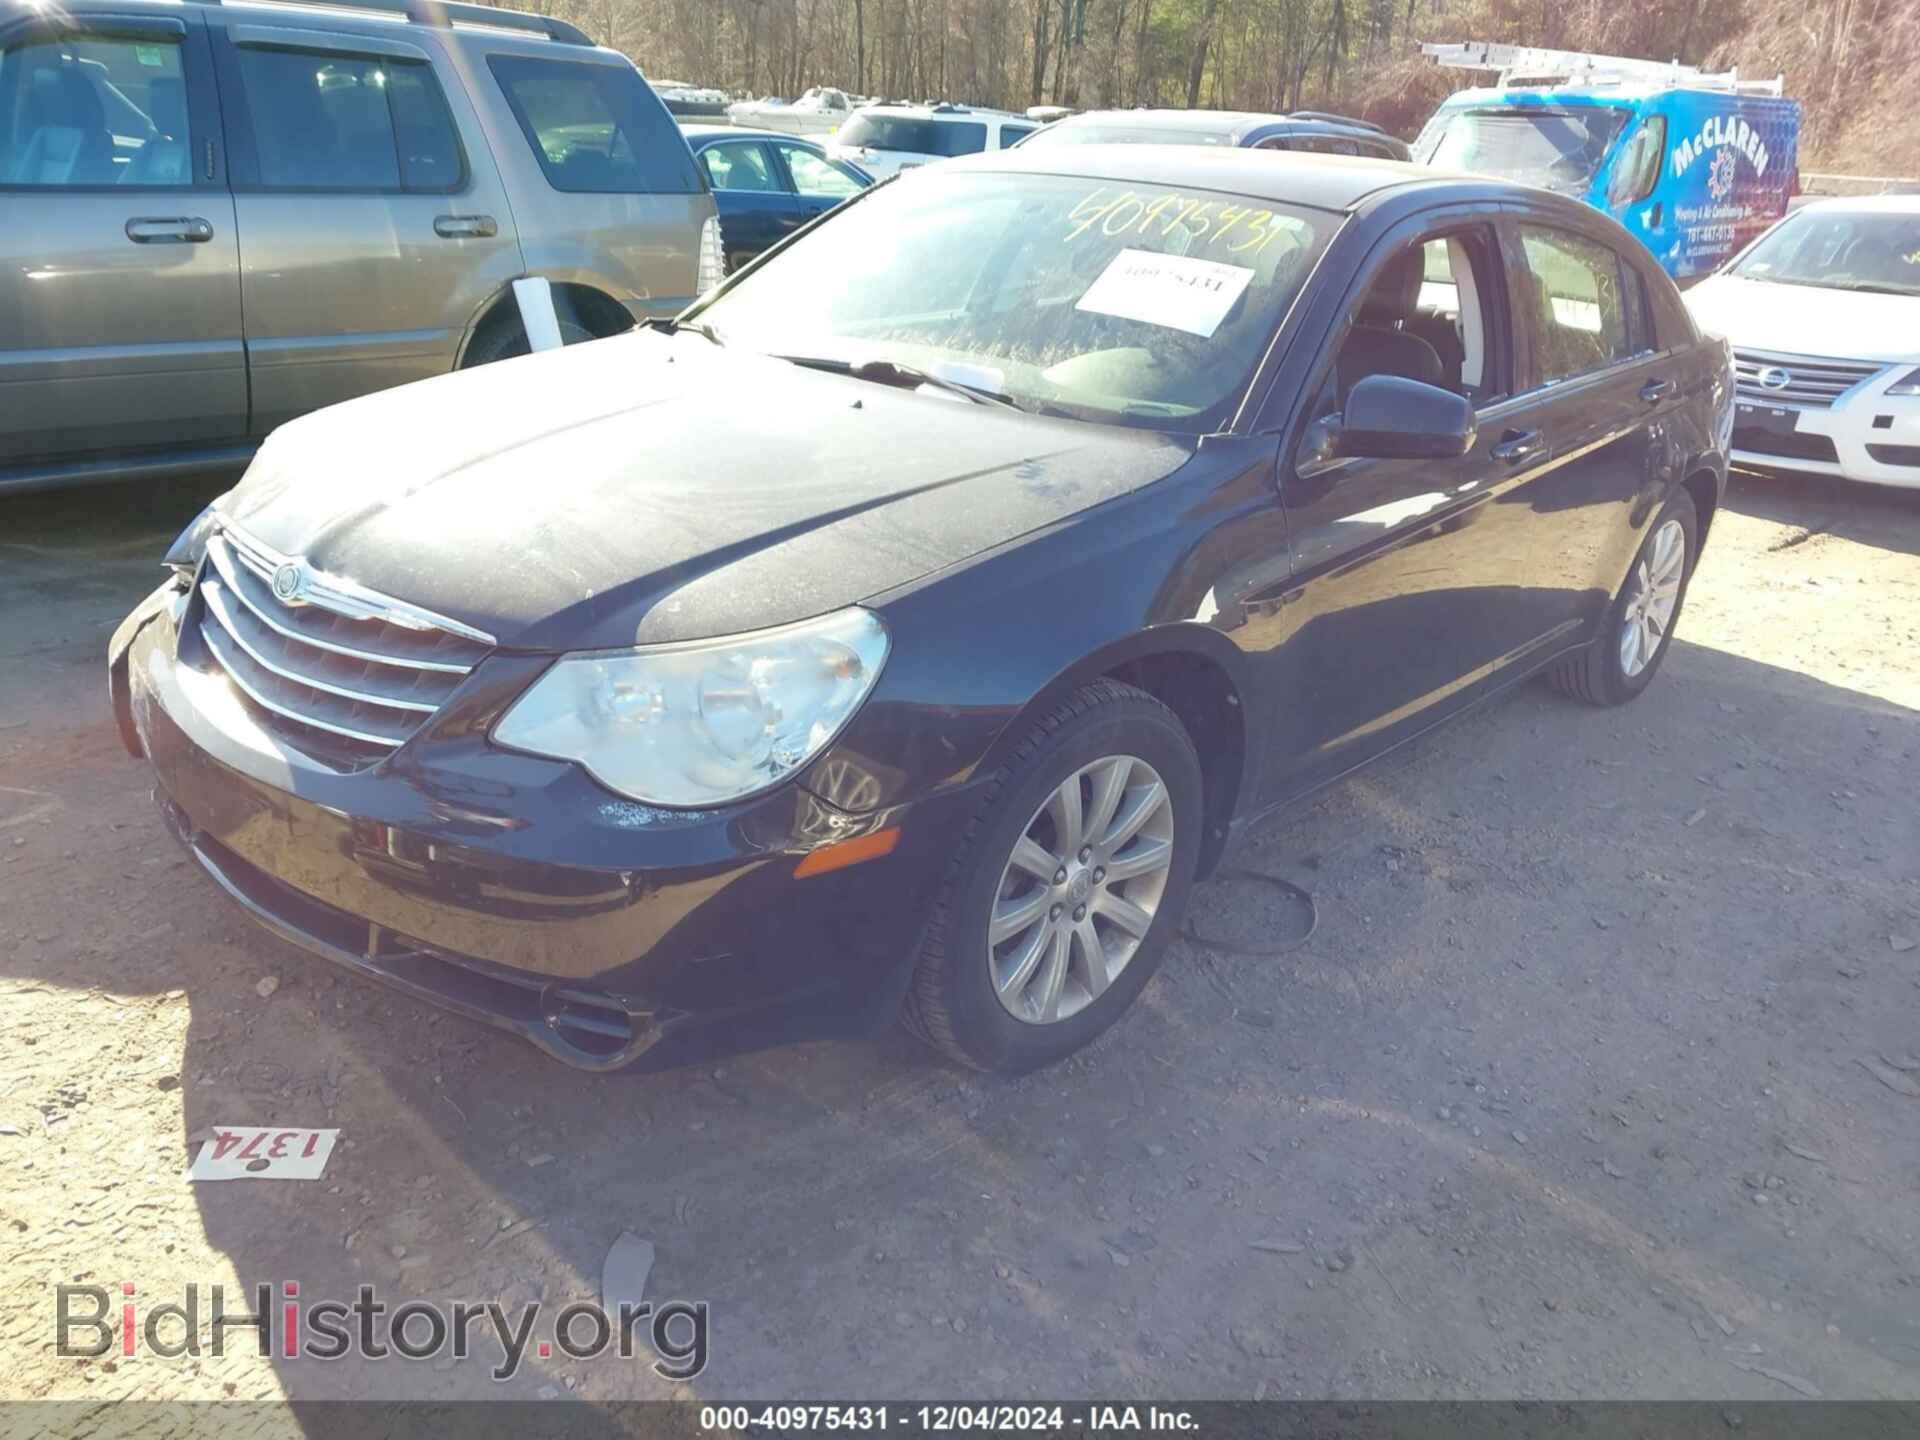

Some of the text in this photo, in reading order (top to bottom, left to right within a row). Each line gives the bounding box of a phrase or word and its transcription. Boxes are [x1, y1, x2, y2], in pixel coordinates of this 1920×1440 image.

[1673, 116, 1769, 178] McCLAREN
[1064, 187, 1282, 256] 40975431
[210, 1131, 320, 1161] 1374
